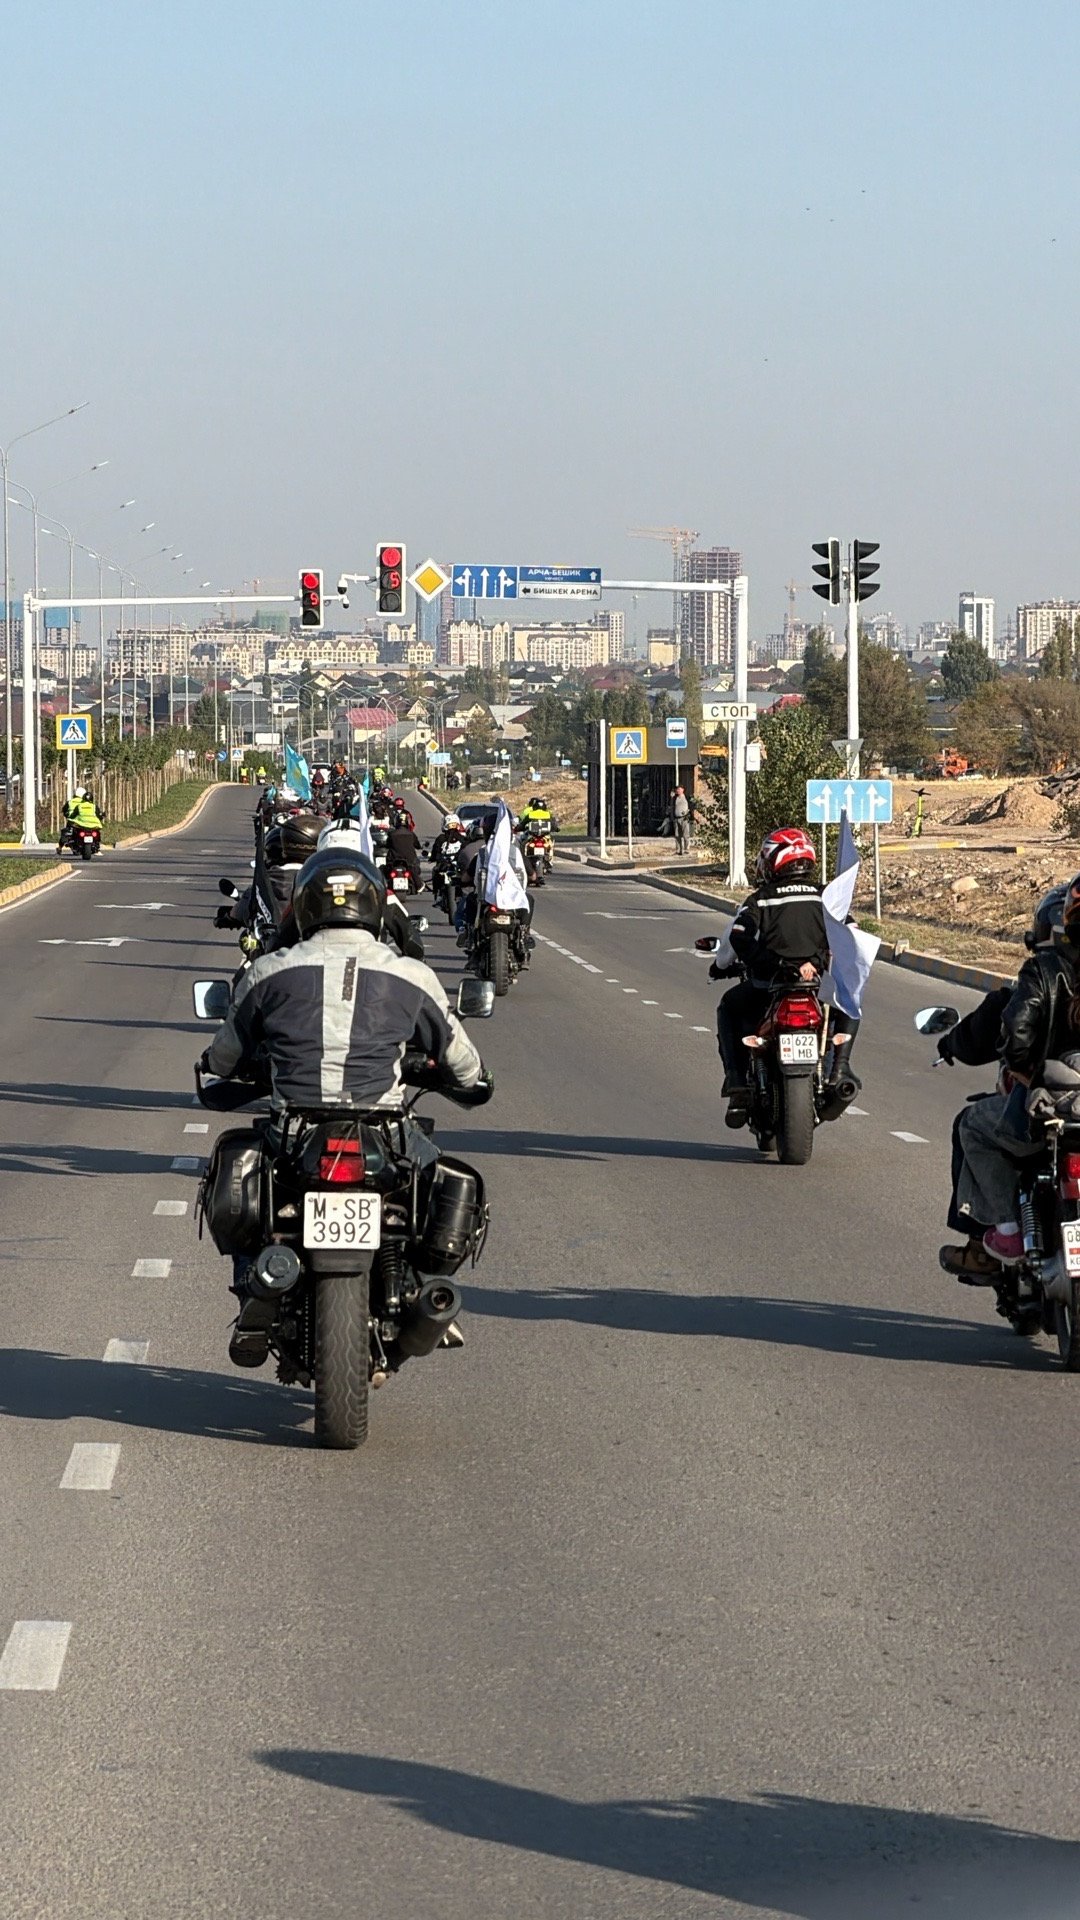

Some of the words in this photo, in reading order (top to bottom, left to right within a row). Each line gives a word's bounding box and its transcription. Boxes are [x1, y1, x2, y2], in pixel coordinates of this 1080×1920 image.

[528, 568, 581, 576] АРЧА-БЕШИК
[711, 706, 749, 717] СТОП
[776, 885, 818, 893] HONDA
[795, 1036, 814, 1046] 622
[798, 1049, 813, 1058] MB
[313, 1221, 371, 1243] 3992
